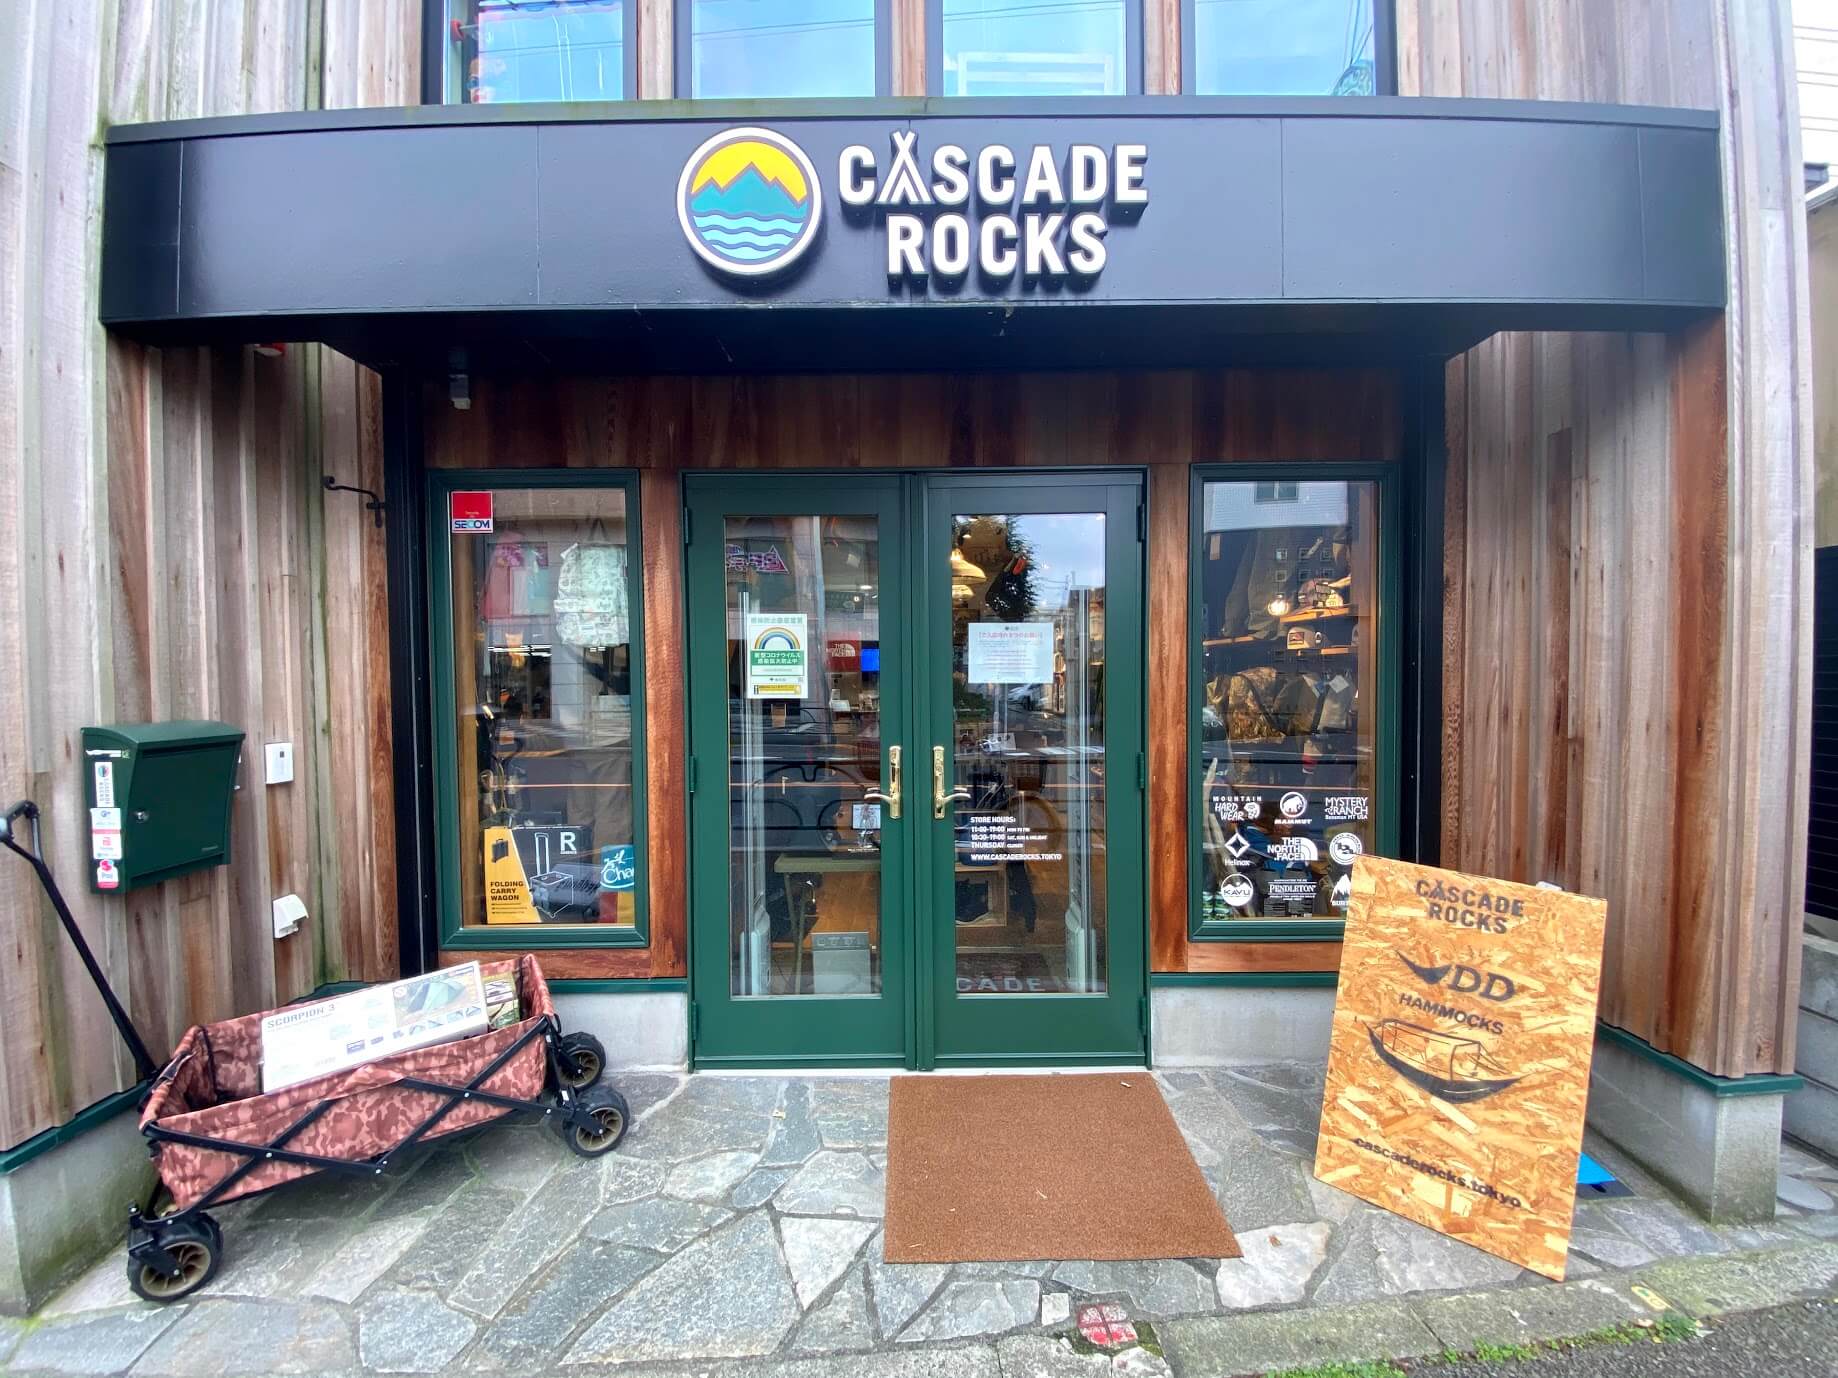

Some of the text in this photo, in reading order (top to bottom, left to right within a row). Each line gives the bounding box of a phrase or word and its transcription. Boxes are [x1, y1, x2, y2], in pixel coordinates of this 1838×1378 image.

[839, 130, 1147, 205] CASCADE
[887, 214, 1107, 274] ROCKS
[454, 520, 490, 528] SECOM
[1215, 802, 1238, 812] HARD
[1325, 797, 1368, 806] MYSTERY
[1333, 806, 1368, 815] RANCH
[1220, 810, 1244, 821] WEAR
[560, 832, 576, 851] R
[1267, 845, 1301, 853] NORTH
[1281, 837, 1301, 845] THE
[1269, 884, 1316, 893] PENDLETON
[1415, 879, 1525, 917] CASCADE
[1428, 902, 1509, 934] ROCKS
[1447, 963, 1516, 1003] DD
[267, 1006, 324, 1029] SCORPION
[328, 1003, 336, 1011] 3
[1399, 992, 1504, 1035] HAMMOCKS
[1352, 1137, 1521, 1208] cascaderocks.tokyo
